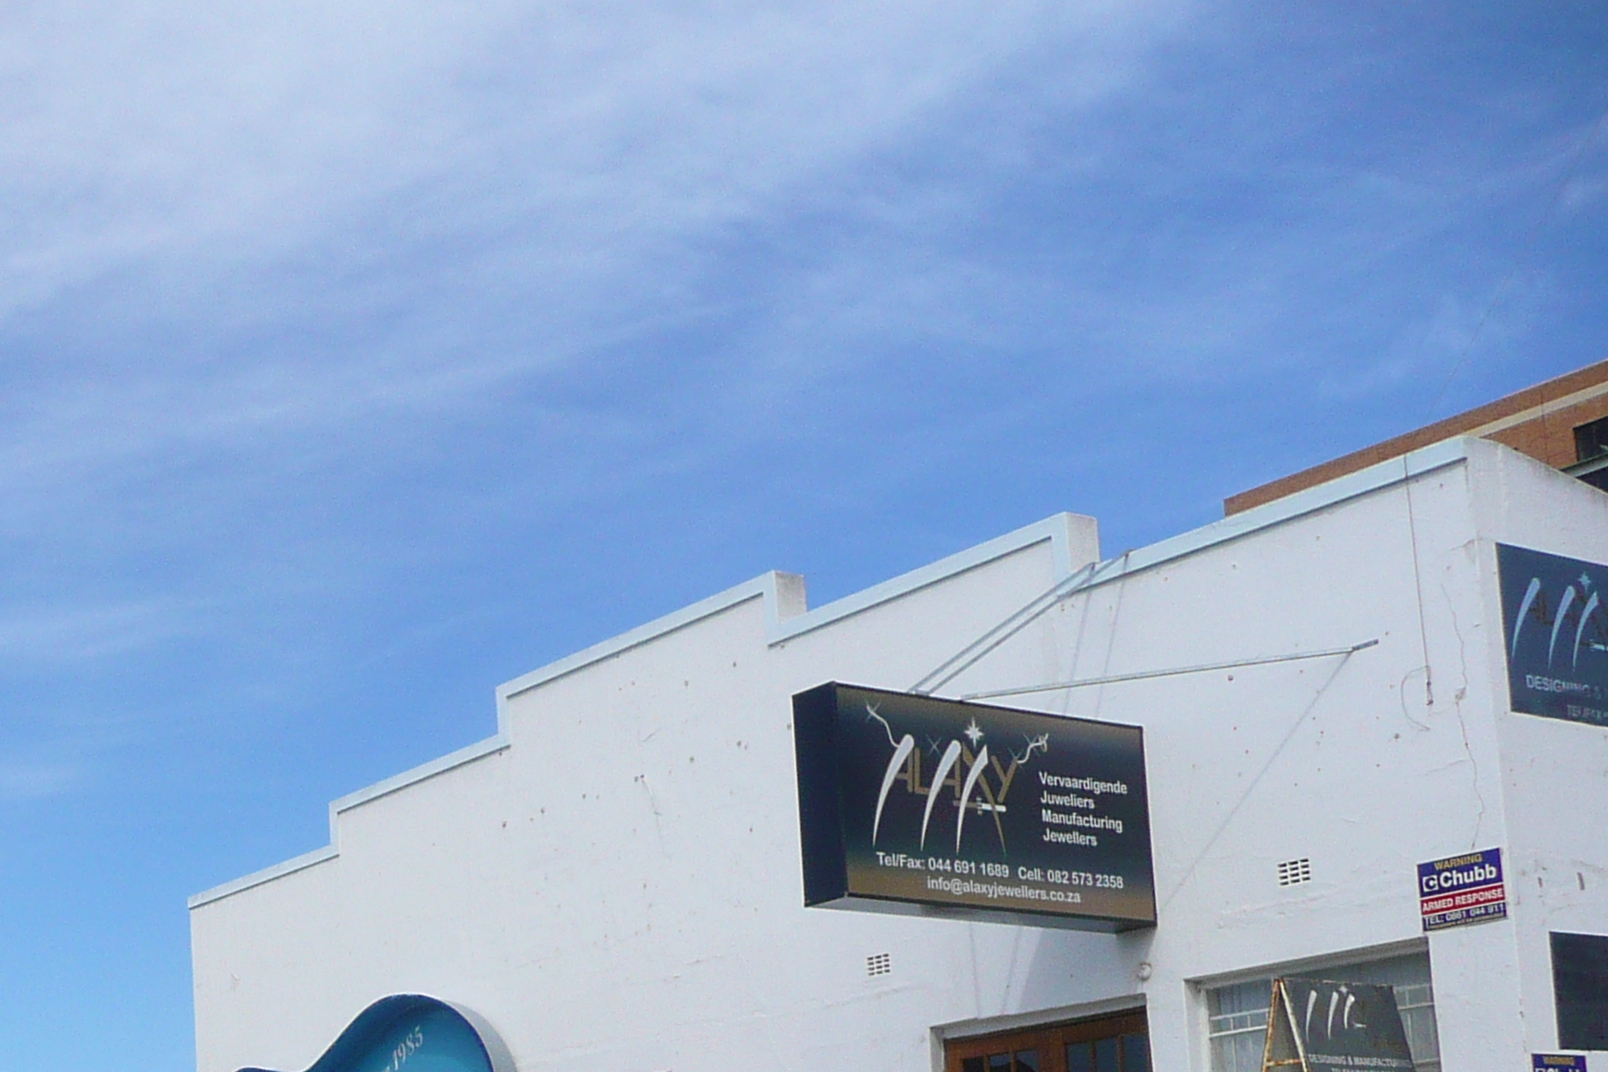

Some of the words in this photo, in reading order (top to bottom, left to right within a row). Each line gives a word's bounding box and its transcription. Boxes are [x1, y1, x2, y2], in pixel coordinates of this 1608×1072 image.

[1038, 771, 1128, 795] Vervaardigende
[1040, 790, 1095, 810] Juweliers
[1042, 809, 1123, 834] Manufacturing
[1043, 828, 1098, 847] Jewellers
[876, 851, 926, 871] Tel/Fax:
[928, 857, 952, 872] 044
[954, 860, 976, 876] 691
[980, 862, 1009, 878] 1689
[1018, 866, 1045, 882] Cell:
[1047, 869, 1069, 884] 082
[1072, 872, 1093, 887] 573
[1096, 874, 1124, 890] 2358
[1434, 853, 1483, 871] WARNING
[1439, 864, 1497, 888] Chubb
[927, 876, 1082, 904] info@alaxyjewellers.co.za
[1422, 897, 1454, 913] ARMED
[1455, 887, 1504, 905] RESPONSE
[391, 1025, 425, 1071] 1985
